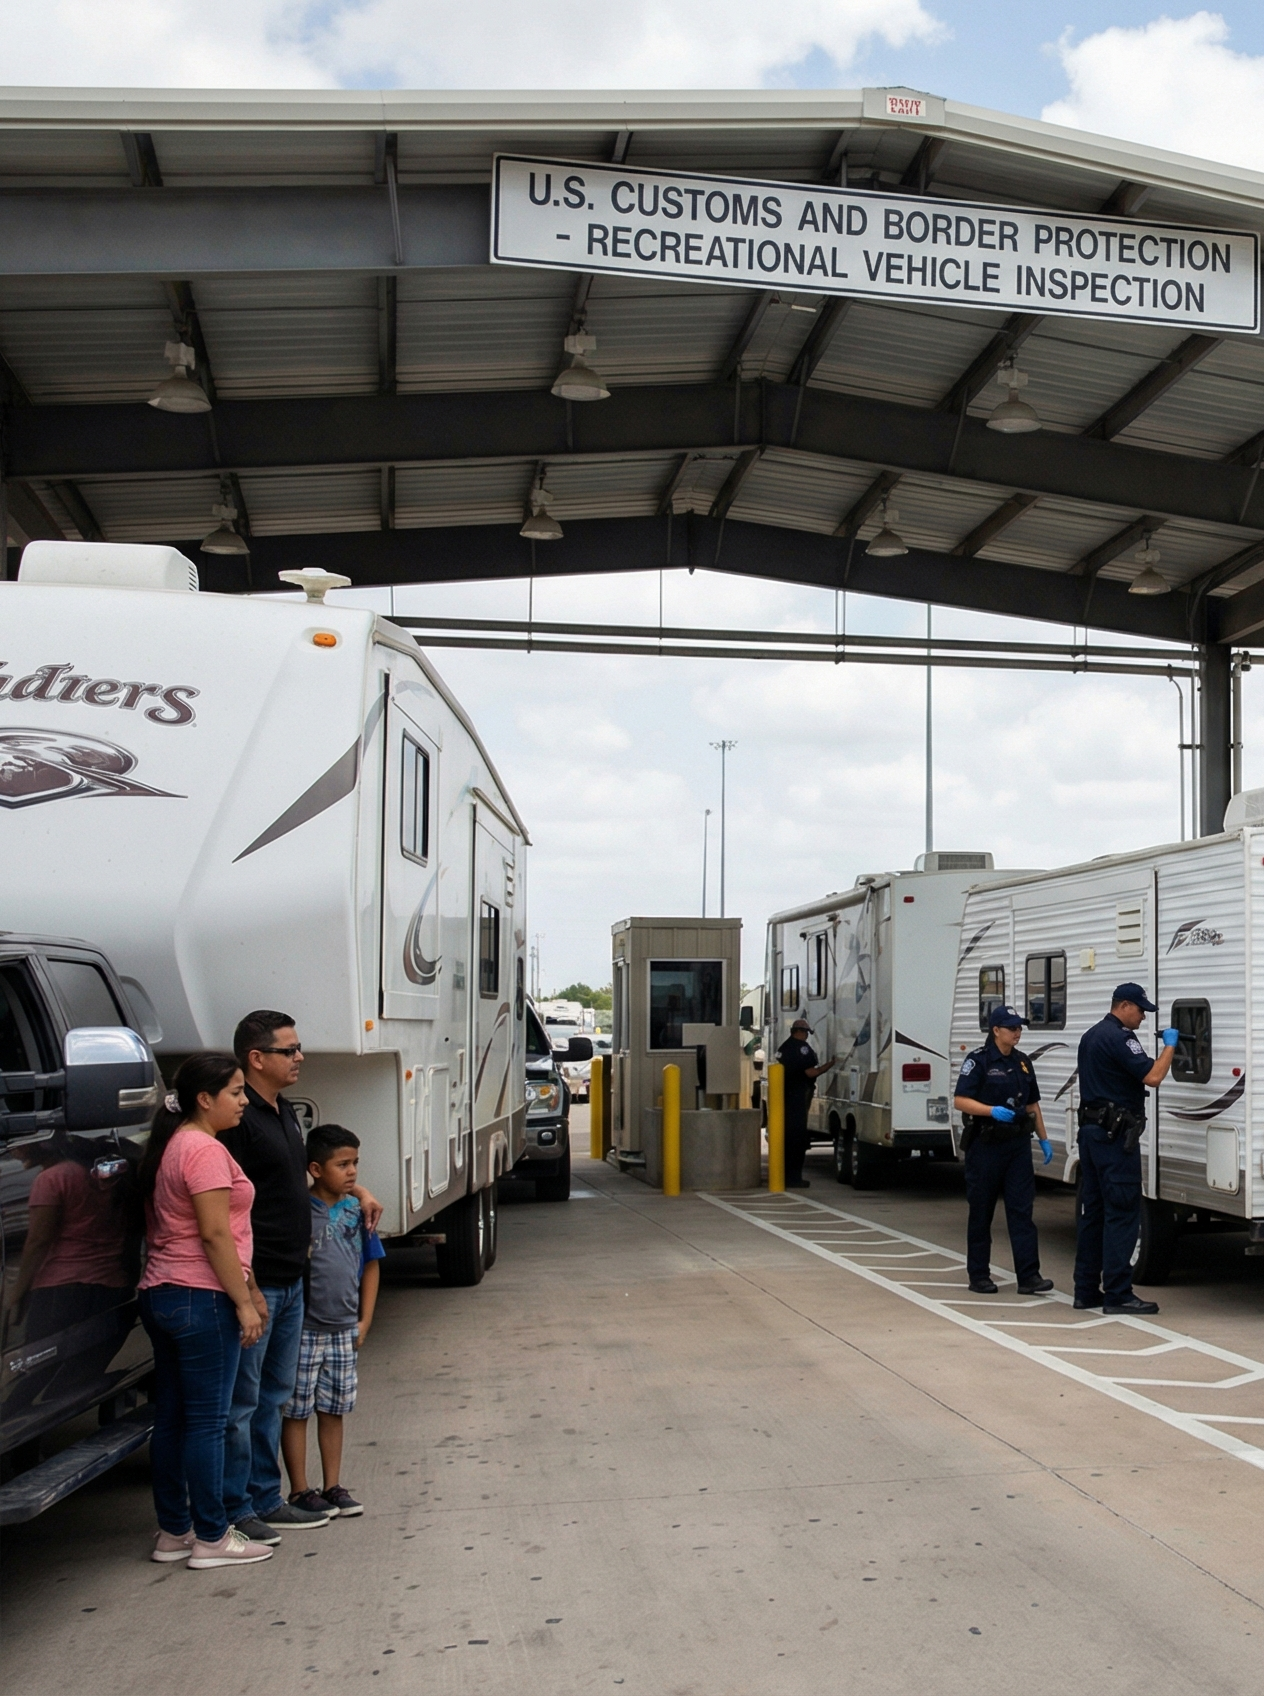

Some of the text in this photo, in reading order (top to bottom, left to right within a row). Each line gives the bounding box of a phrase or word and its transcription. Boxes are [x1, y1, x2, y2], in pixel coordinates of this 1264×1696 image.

[529, 172, 1231, 273] U.S. CUSTOMS AND BORDER PROTECTION
[587, 223, 848, 279] RECREATIONAL
[863, 250, 1000, 293] VEHICLE
[1016, 264, 1205, 313] INSPECTION
